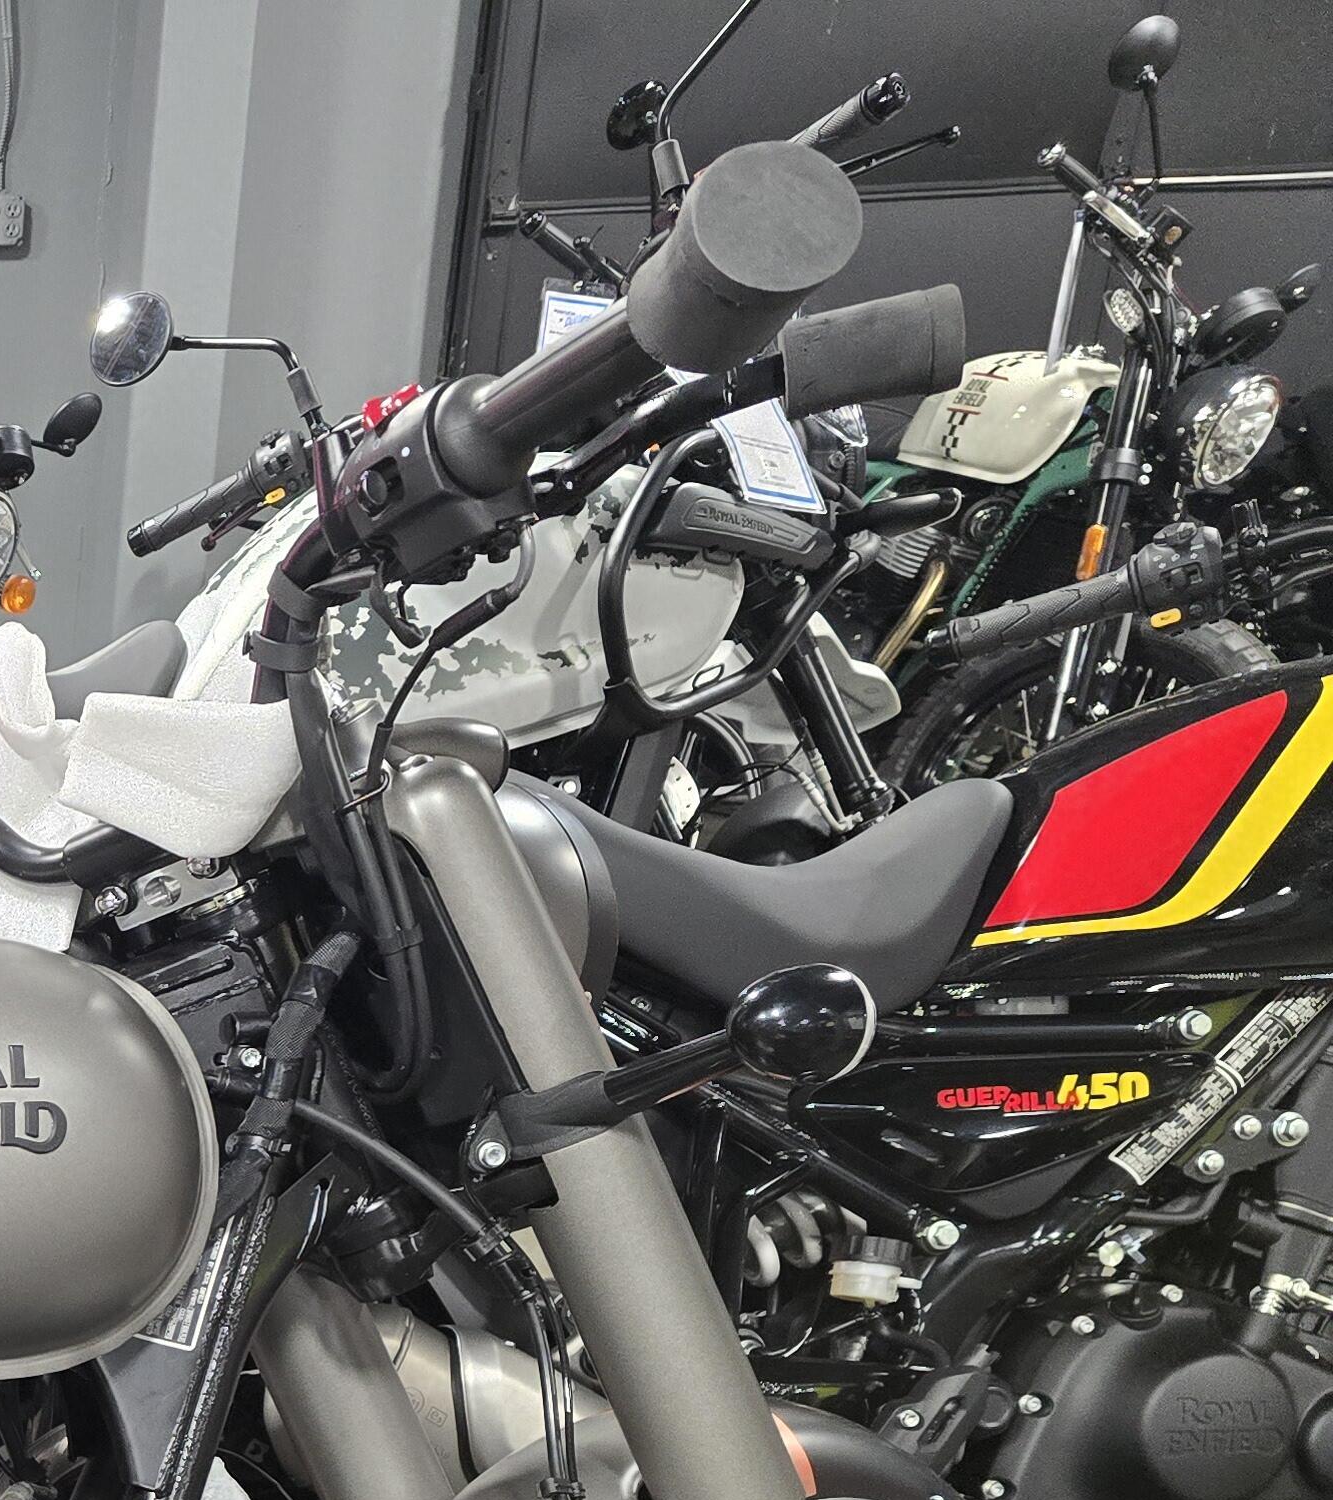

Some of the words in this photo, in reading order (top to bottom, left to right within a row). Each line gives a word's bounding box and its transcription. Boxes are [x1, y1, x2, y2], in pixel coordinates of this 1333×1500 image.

[708, 506, 741, 526] ROYAL
[936, 1086, 1080, 1113] GUERRILLA
[1057, 1071, 1150, 1111] 450
[1177, 1396, 1276, 1426] ROYAL
